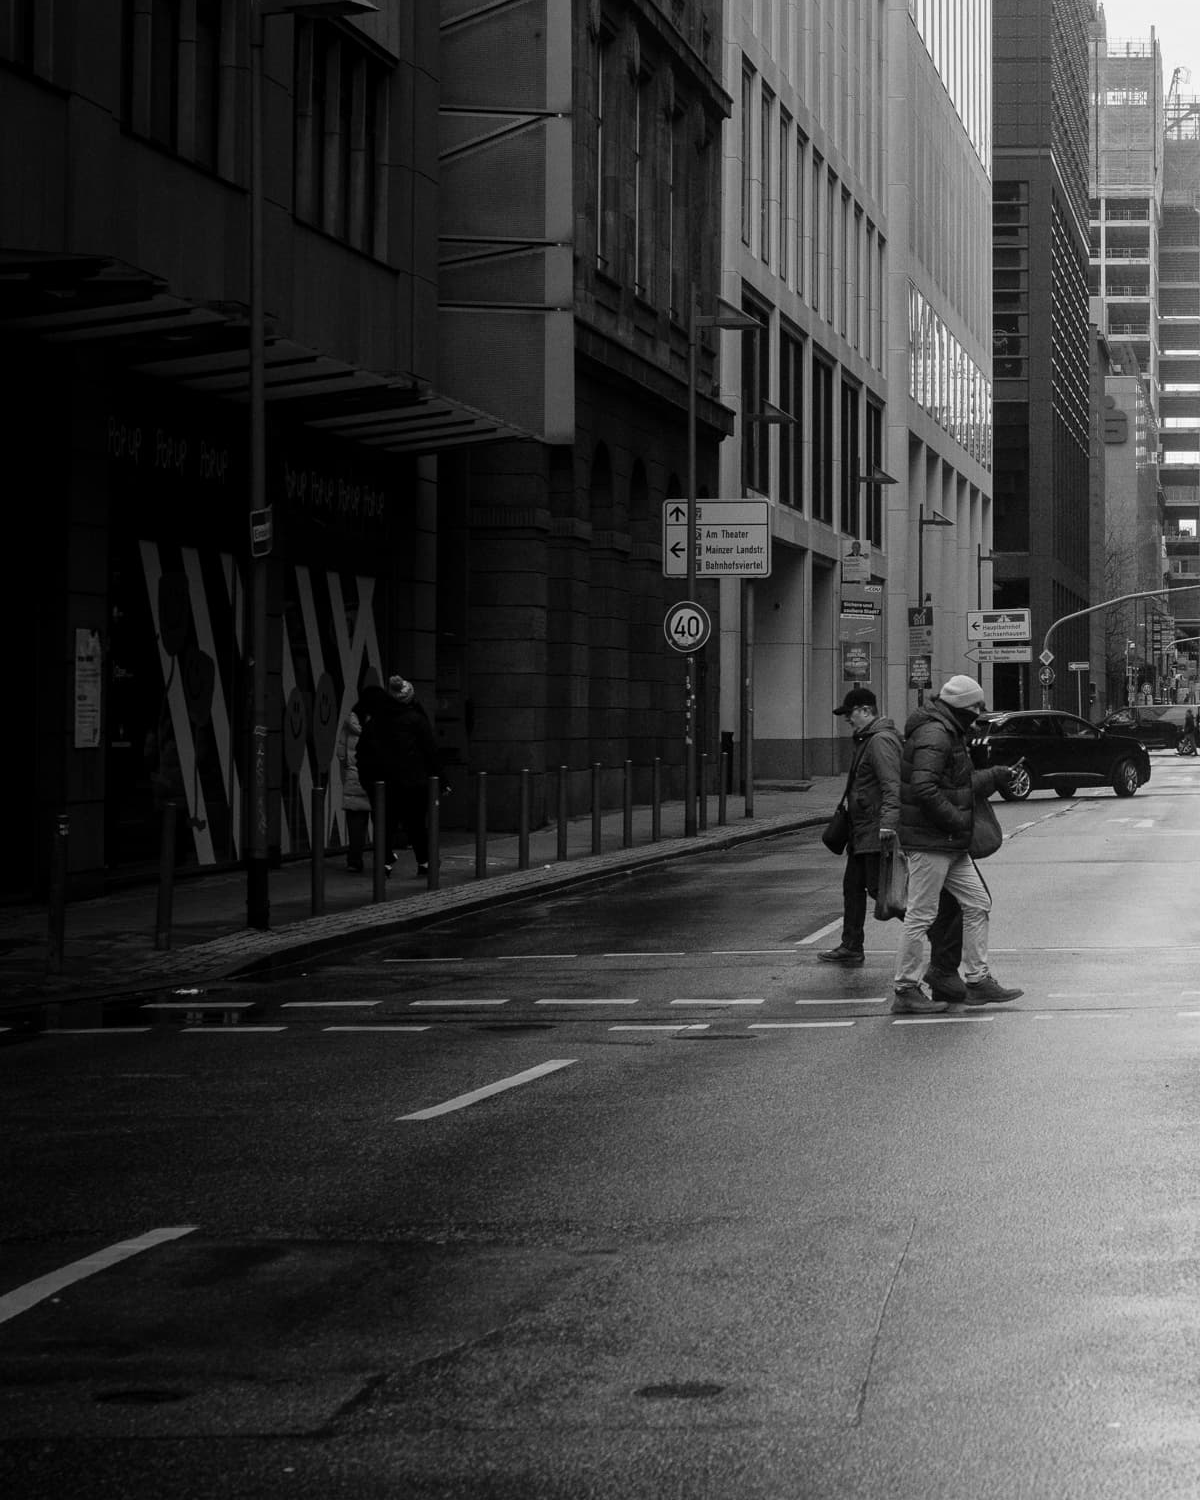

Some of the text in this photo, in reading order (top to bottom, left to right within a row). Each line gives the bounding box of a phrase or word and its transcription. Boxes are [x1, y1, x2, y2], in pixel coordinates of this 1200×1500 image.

[706, 529, 748, 539] Am Theater
[705, 545, 764, 554] Mainzer Landstr.
[705, 560, 763, 570] Bahnhofsviertel
[674, 616, 700, 637] 40
